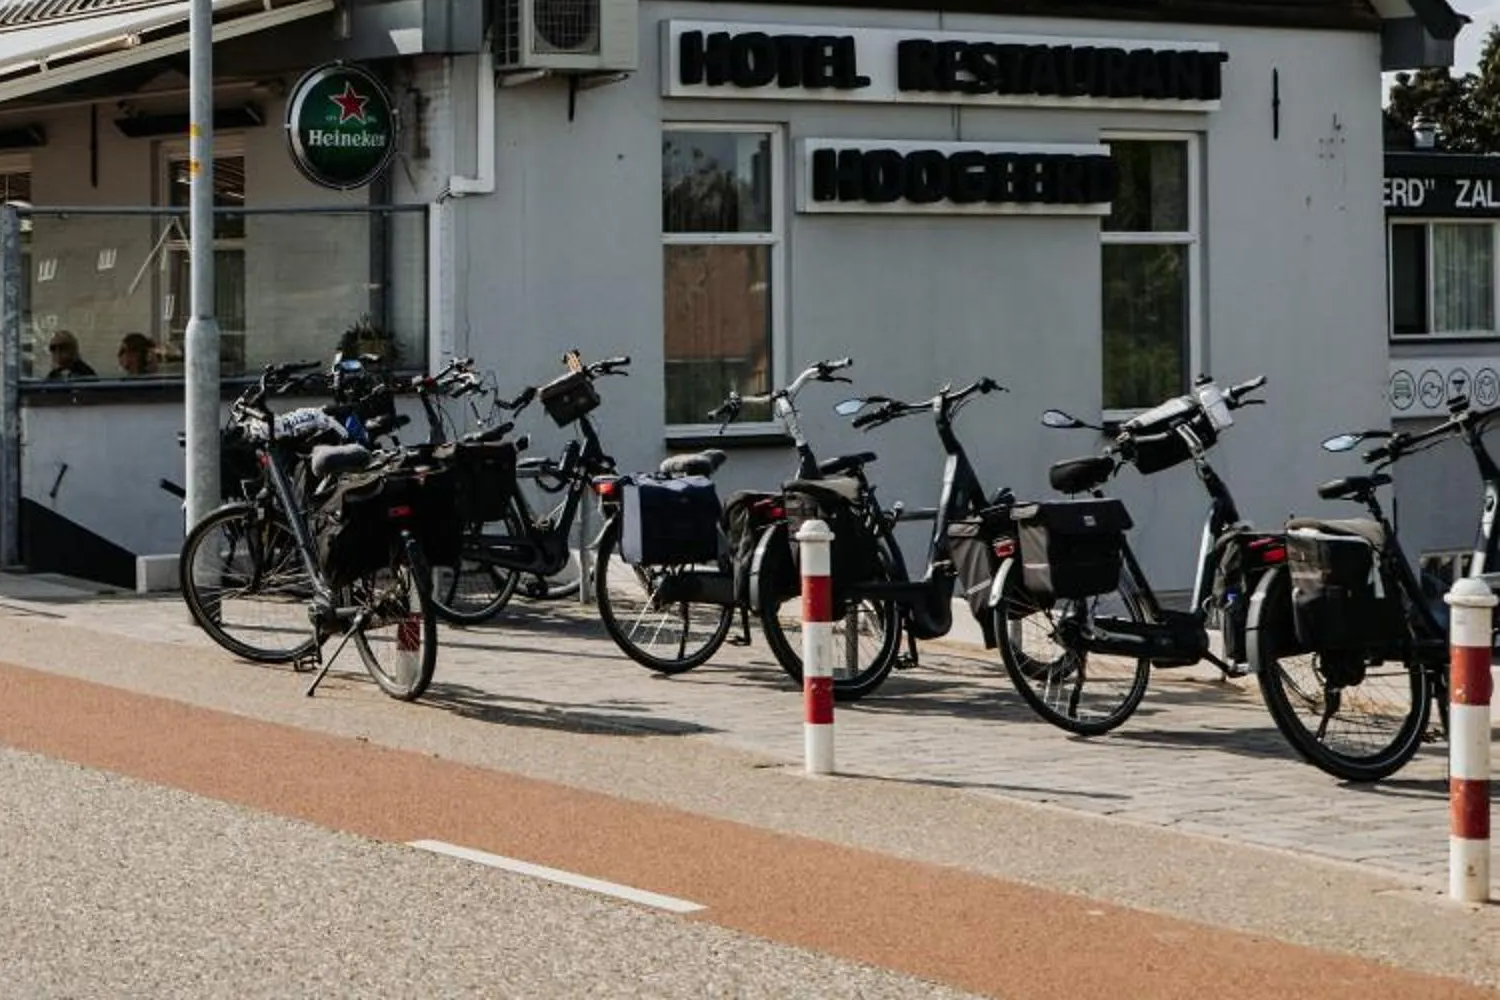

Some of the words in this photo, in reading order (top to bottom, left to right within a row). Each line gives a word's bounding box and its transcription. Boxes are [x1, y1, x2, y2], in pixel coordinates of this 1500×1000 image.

[680, 30, 871, 88] HOTEL
[898, 39, 1229, 100] RESTAURANT
[813, 148, 1119, 204] HOOGEERD
[1455, 179, 1500, 208] ZAL
